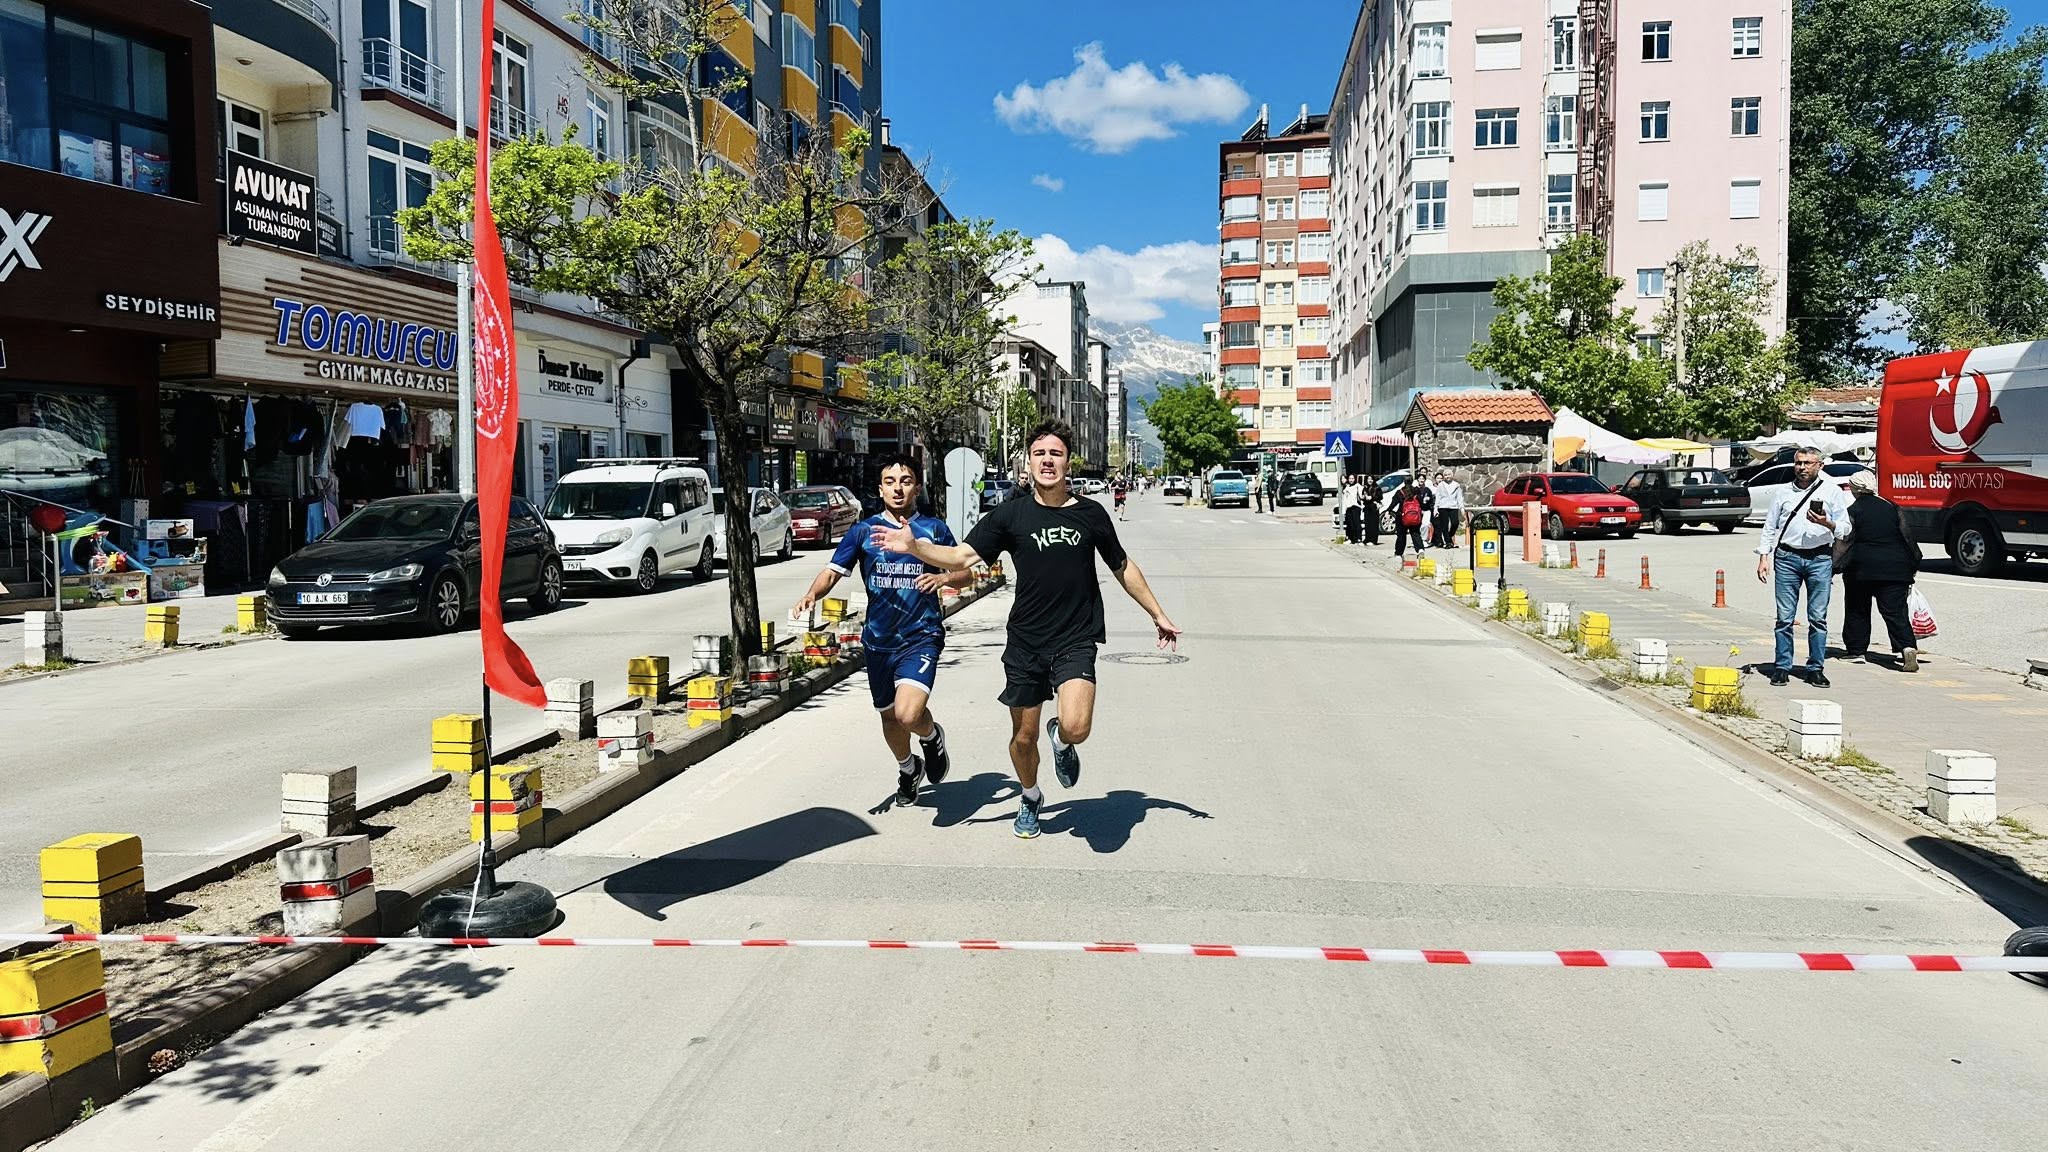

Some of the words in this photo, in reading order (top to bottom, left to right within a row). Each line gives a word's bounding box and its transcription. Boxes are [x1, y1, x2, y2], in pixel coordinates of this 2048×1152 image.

[234, 165, 311, 211] AVUKAT
[235, 199, 279, 223] ASUMAN
[280, 211, 312, 232] GÜROL
[247, 217, 301, 242] TURANBOY
[105, 294, 216, 322] SEYDİŞEHİR
[319, 360, 365, 382] GİYİM
[370, 366, 450, 393] MAĞAZASI
[1892, 470, 1927, 489] MOBİL
[1928, 471, 1952, 490] GÖÇ
[1953, 472, 2004, 489] NOKTASI
[302, 594, 311, 603] 10
[315, 594, 328, 603] AJK
[332, 594, 347, 603] 663
[919, 658, 931, 674] 7
